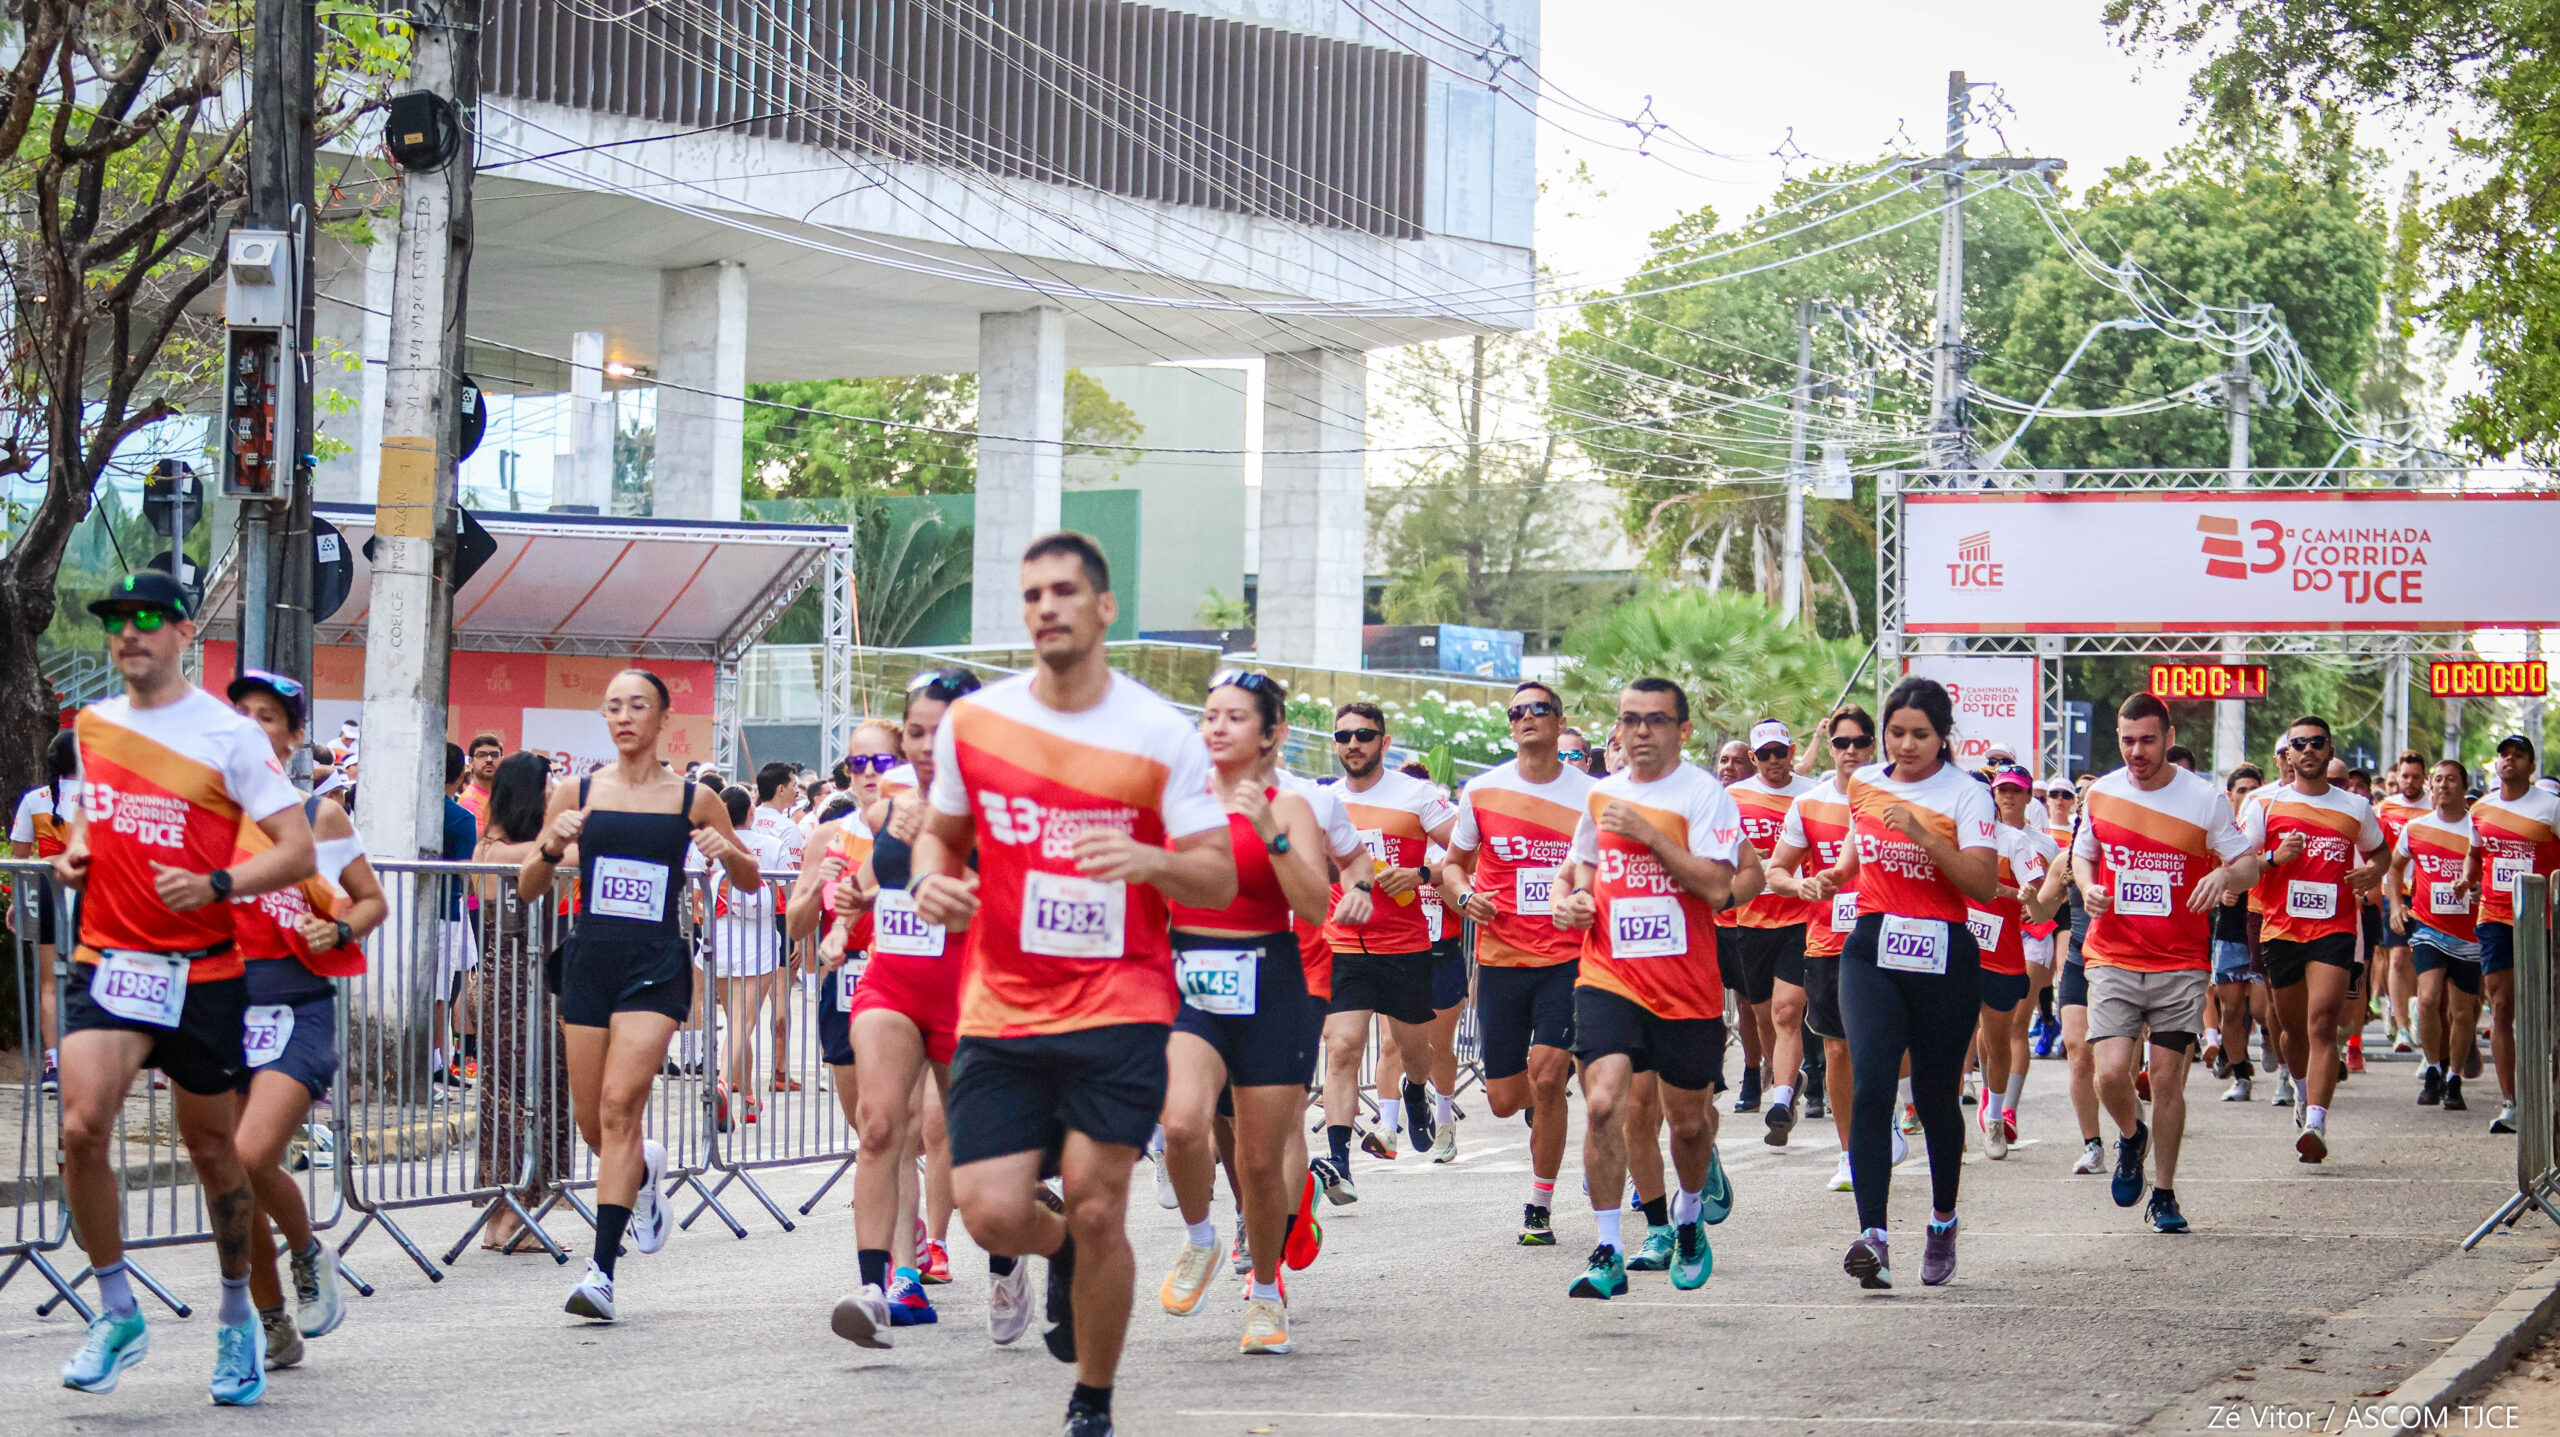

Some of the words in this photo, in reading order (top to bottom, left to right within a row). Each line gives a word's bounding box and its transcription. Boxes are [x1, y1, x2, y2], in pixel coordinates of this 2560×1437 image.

[2302, 528, 2432, 544] CAMINHADA
[2293, 545, 2428, 566] /CORRIDA
[1947, 563, 2004, 586] TJCE
[2293, 568, 2333, 592] DO
[2338, 570, 2423, 604] TJCE
[390, 592, 404, 648] COELCE
[2152, 667, 2265, 696] 00:00:11
[2433, 664, 2545, 693] 00:00:00
[1963, 694, 2018, 703] /CORRIDA
[1966, 686, 2019, 694] CAMINHADA
[1963, 703, 1979, 712] DO
[1982, 703, 2016, 717] TJCE
[121, 791, 190, 812] CAMINHADA
[117, 804, 187, 825] /CORRIDA
[113, 817, 137, 833] DO
[138, 820, 184, 848] TJCE
[1530, 847, 1567, 857] /CORR
[1533, 840, 1570, 848] CAMINH
[1882, 840, 1926, 853] CAMINHA
[1899, 861, 1936, 881] TJCE
[2169, 871, 2184, 886] CE
[2498, 869, 2512, 881] 19
[604, 877, 651, 902] 1939
[1526, 883, 1551, 901] 205
[1626, 874, 1647, 888] DO
[1648, 875, 1684, 894] TJC
[2124, 884, 2162, 902] 1989
[2295, 893, 2327, 908] 1953
[2436, 893, 2463, 905] 197
[1041, 901, 1105, 933] 1982
[1840, 905, 1856, 919] 20
[884, 911, 928, 936] 2115
[1620, 916, 1670, 940] 1975
[1966, 921, 1991, 939] 081
[1888, 934, 1934, 957] 2079
[110, 971, 168, 1001] 1986
[1188, 971, 1239, 995] 1145
[245, 1026, 277, 1049] 73
